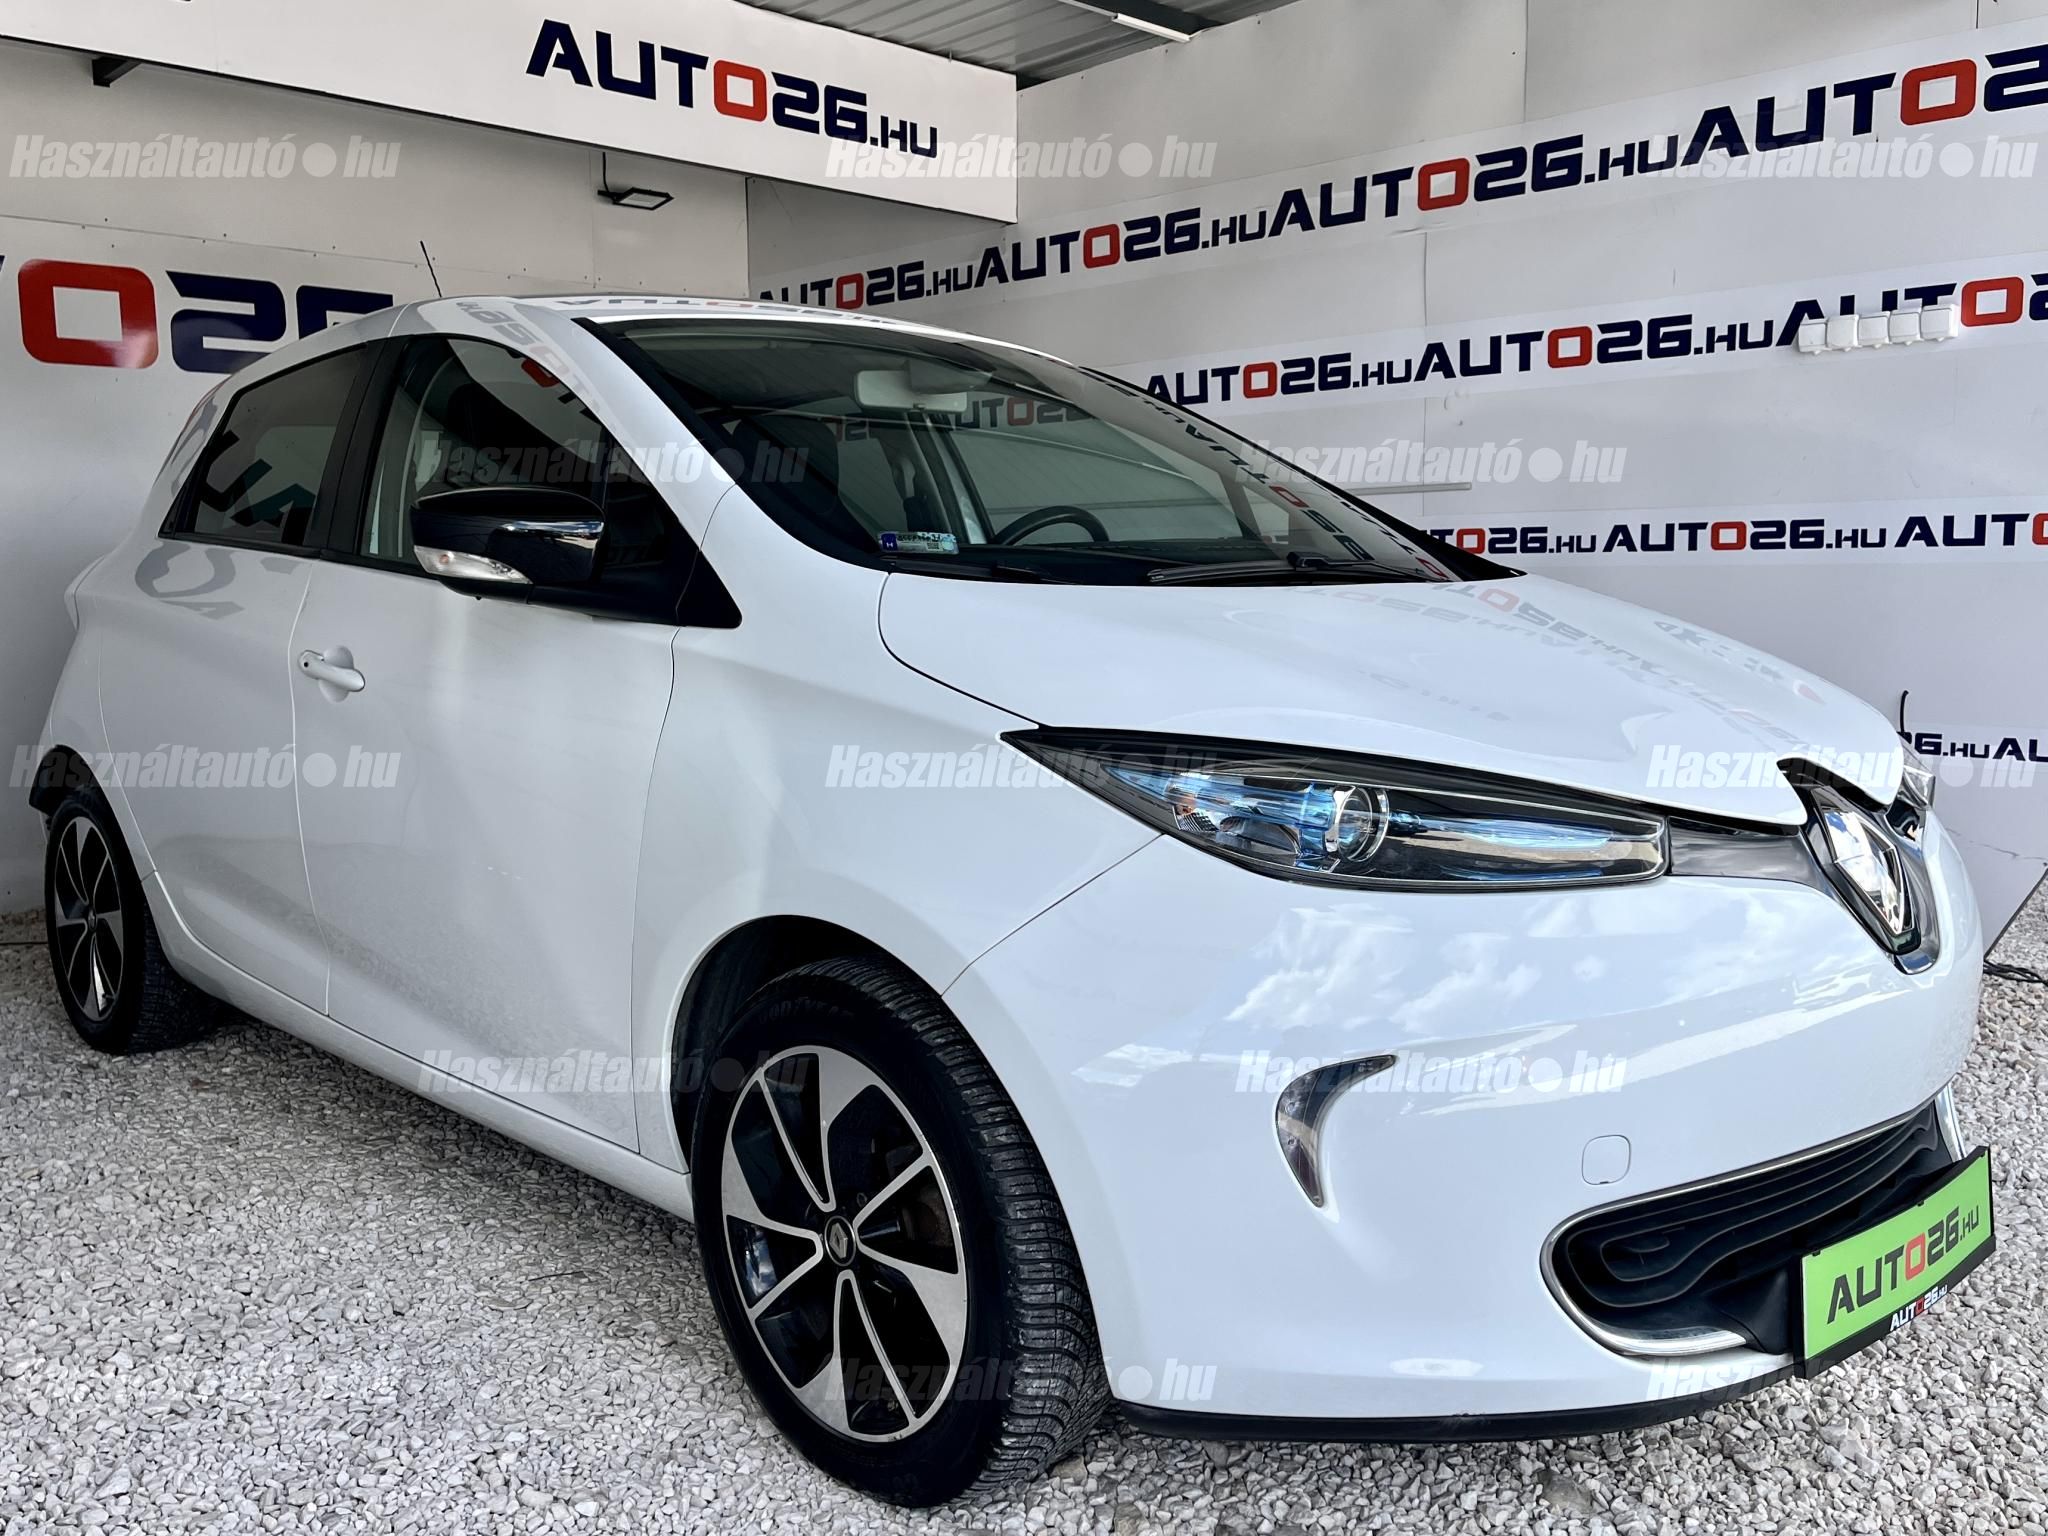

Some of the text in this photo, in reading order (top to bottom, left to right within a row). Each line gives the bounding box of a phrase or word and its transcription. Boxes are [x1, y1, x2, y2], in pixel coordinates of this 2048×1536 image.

[526, 19, 938, 158] AUTO26.HU
[974, 207, 1266, 284] AUTO26.HU
[1268, 134, 1679, 237] AUTO26.HU
[1146, 352, 1412, 406] AUTO26.HU
[1413, 313, 1774, 382] AUTO26.HU
[1602, 519, 1887, 553] AUTO26.HU
[1827, 1206, 1979, 1325] AUTO26.HU
[1890, 1284, 1949, 1332] AUTO26.HU
